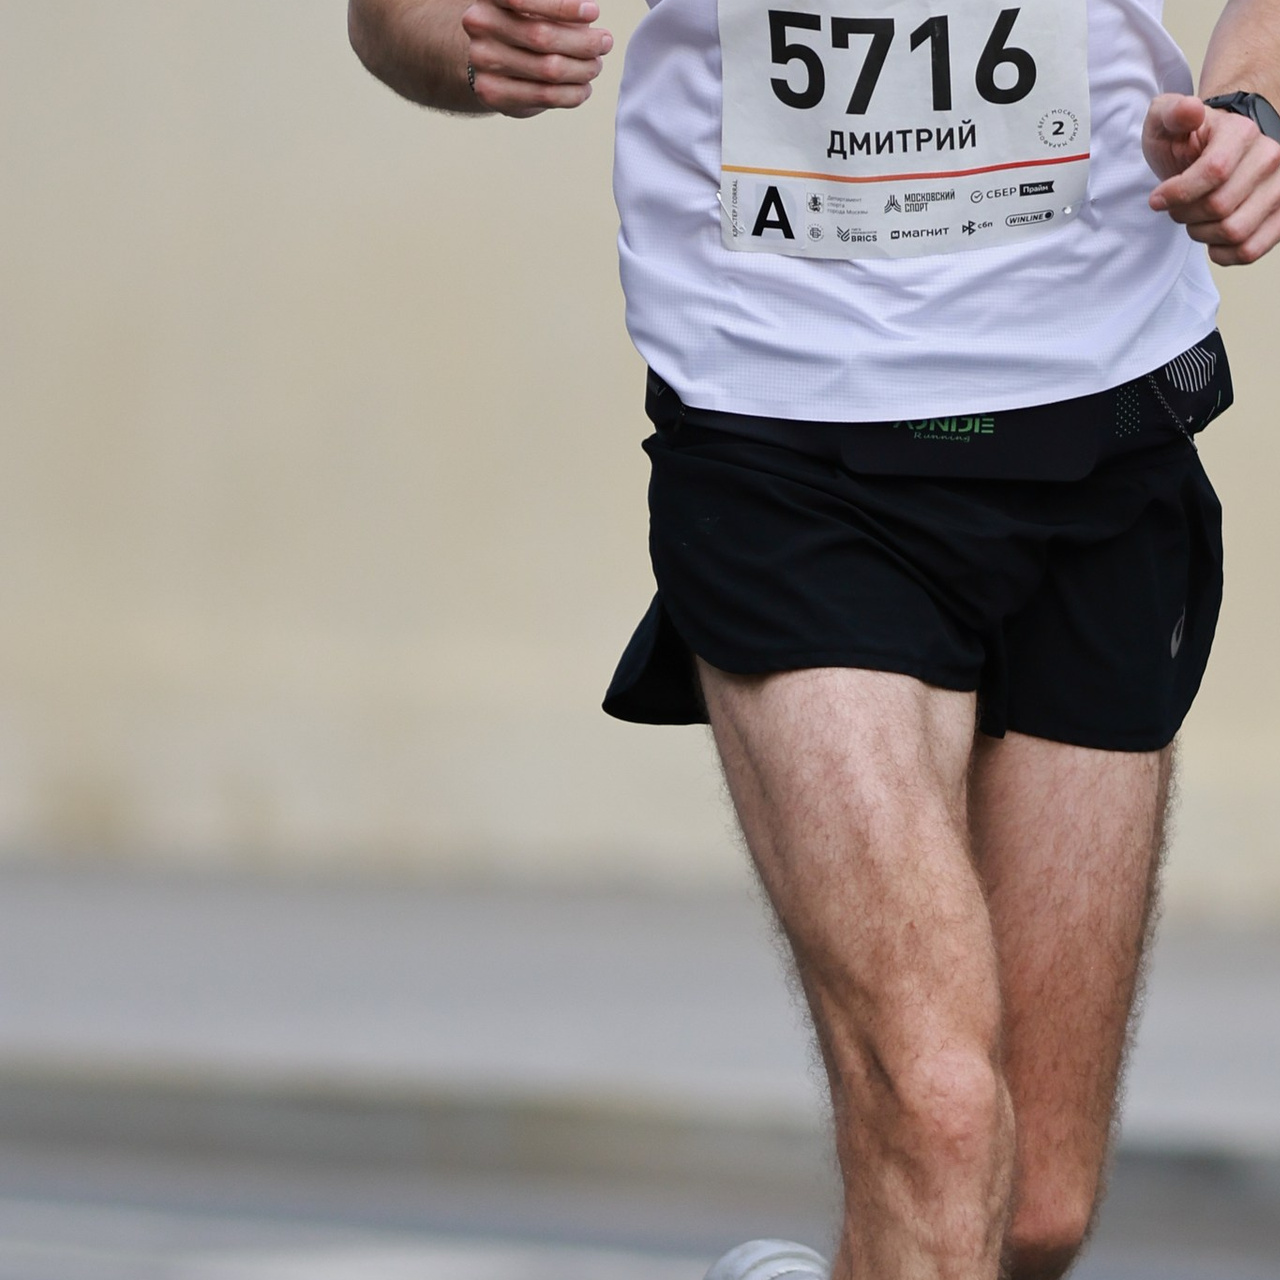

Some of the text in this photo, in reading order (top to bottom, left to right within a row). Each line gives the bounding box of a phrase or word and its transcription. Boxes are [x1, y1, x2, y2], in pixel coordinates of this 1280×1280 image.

[767, 7, 1037, 115] 5716
[1052, 120, 1065, 136] 2
[826, 119, 977, 160] ДМИТРИЙ
[904, 189, 956, 203] МОСКОВСКИЙ
[986, 185, 1049, 199] СБЕР Прайм
[904, 202, 929, 213] СПОРТ
[977, 221, 993, 229] сбп
[1009, 214, 1044, 224] WINLINE
[850, 234, 878, 243] BRICS
[901, 227, 950, 239] магнит
